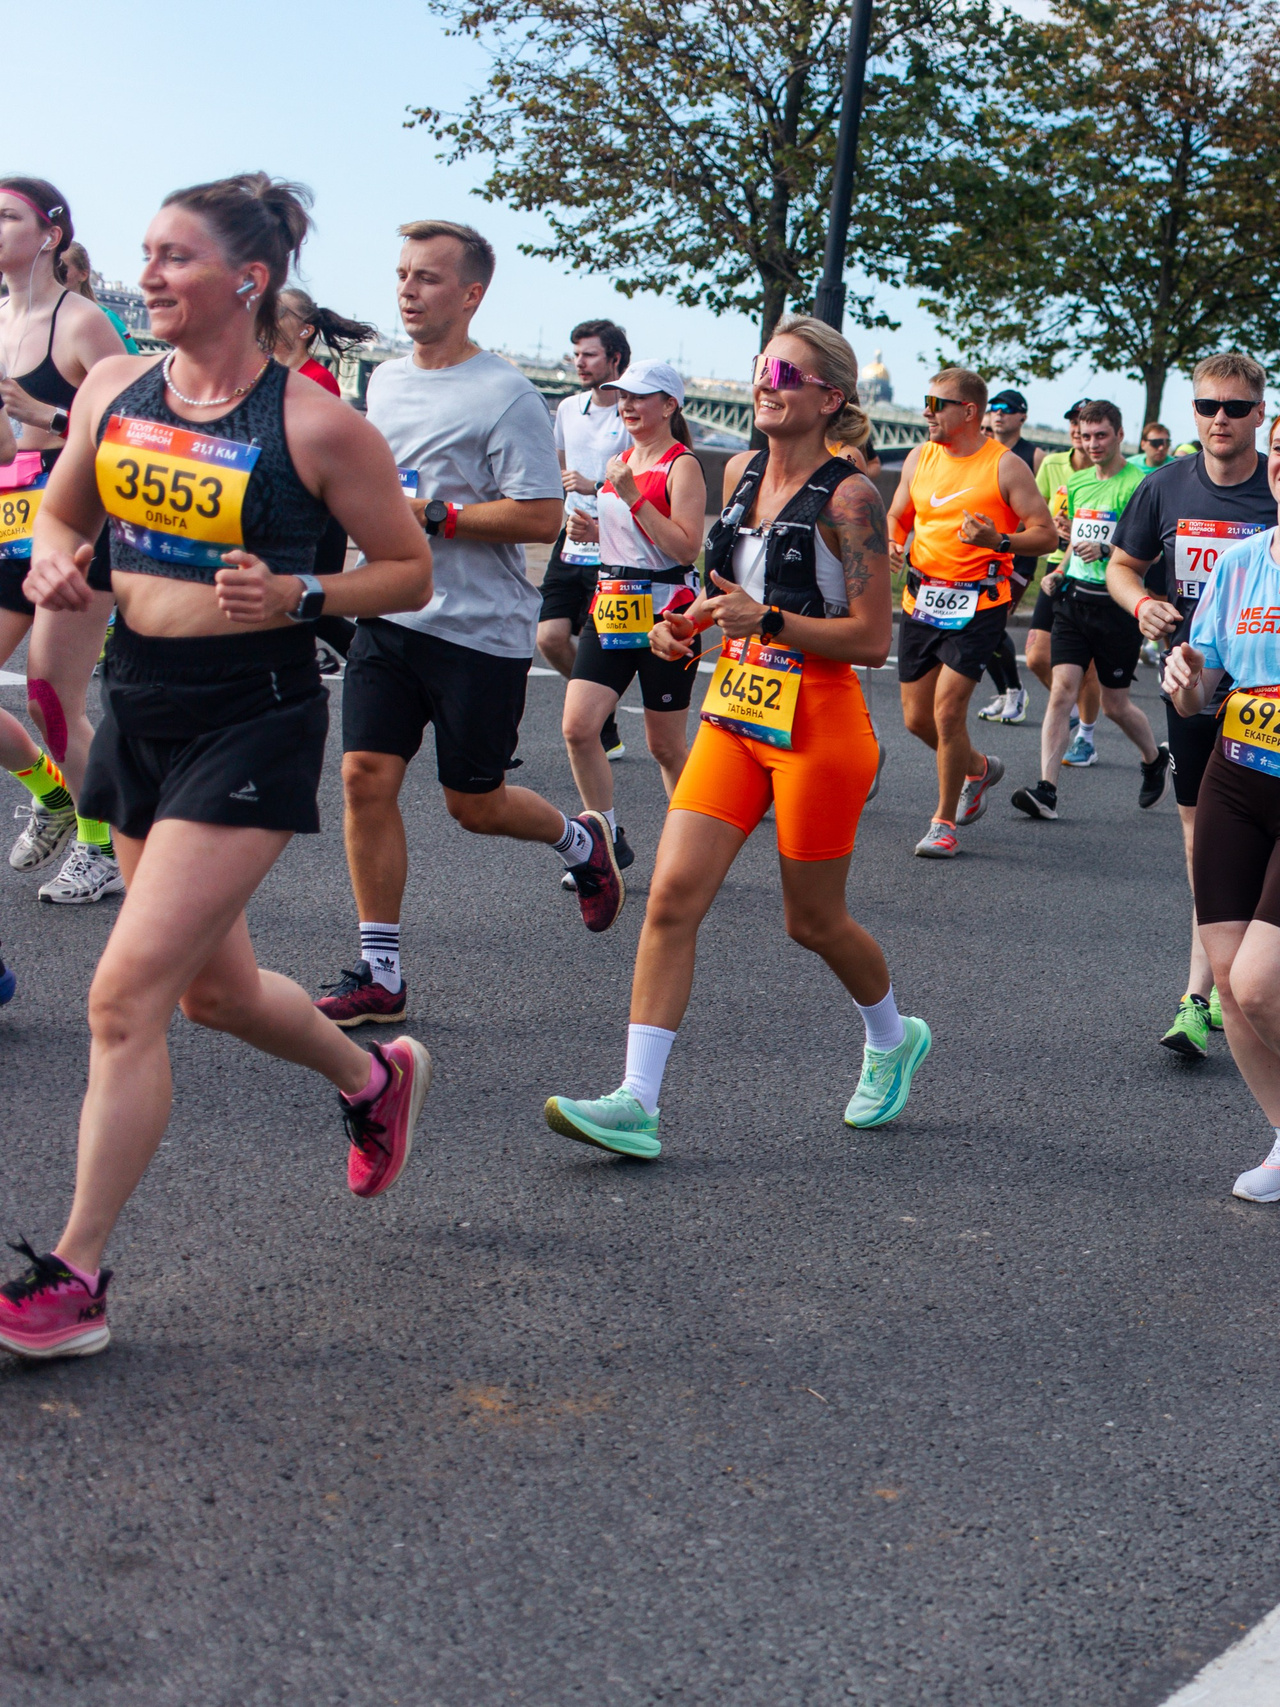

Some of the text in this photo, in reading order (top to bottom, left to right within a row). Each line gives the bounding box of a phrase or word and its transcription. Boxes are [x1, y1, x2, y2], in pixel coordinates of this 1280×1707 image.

[129, 422, 154, 432] ПОЛУ
[126, 430, 172, 446] МАРАФОН
[191, 442, 238, 461] 21,1 КМ
[115, 458, 223, 519] 3553
[0, 498, 30, 527] 89
[145, 510, 188, 530] ОЛЬГА
[1077, 523, 1110, 540] 6399
[1227, 527, 1241, 535] 21,1
[1187, 547, 1226, 573] 70
[925, 590, 970, 610] 5662
[597, 600, 640, 621] 6451
[606, 622, 628, 630] ОЛЬГА
[759, 652, 789, 665] 21,1 КМ
[720, 668, 782, 711] 6452
[727, 703, 764, 719] ТАТЬЯНА
